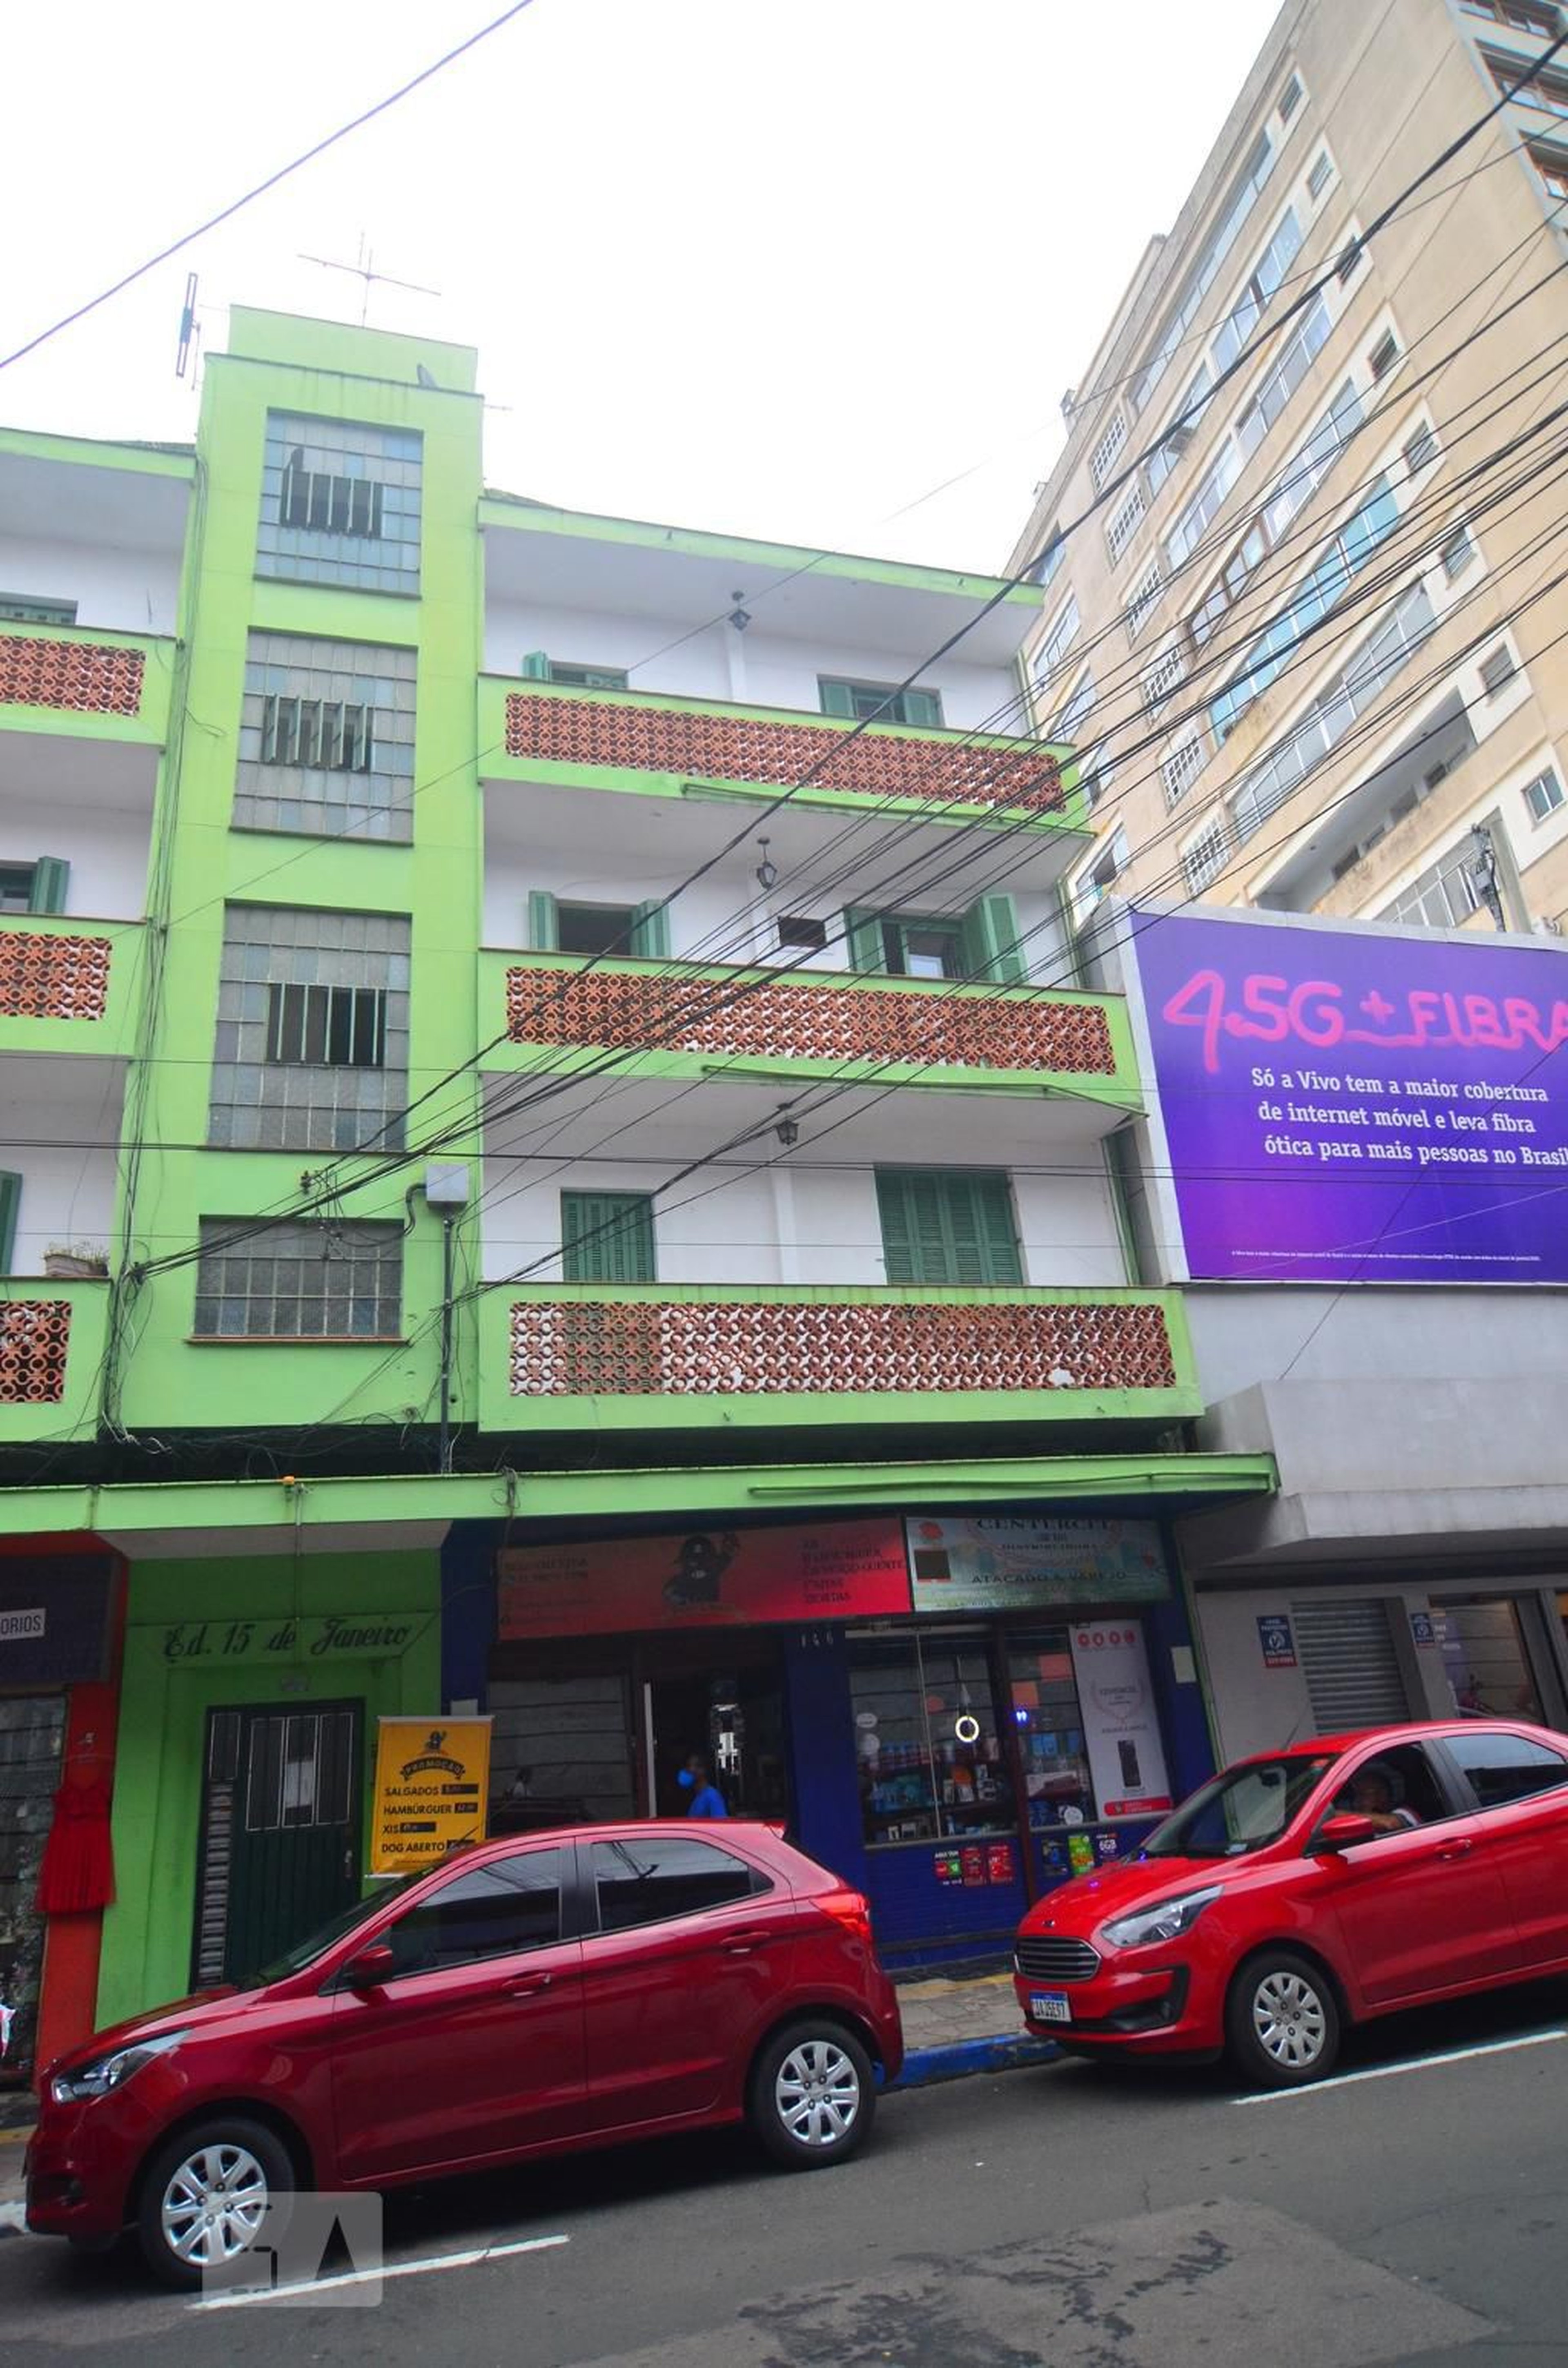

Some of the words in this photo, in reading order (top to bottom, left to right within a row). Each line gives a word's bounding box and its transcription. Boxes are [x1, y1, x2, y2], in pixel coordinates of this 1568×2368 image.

[1252, 1067, 1274, 1087] Só
[1281, 1074, 1294, 1088] a
[1297, 1071, 1341, 1091] Vivo
[1345, 1074, 1384, 1093] tem
[1389, 1080, 1401, 1095] a
[1405, 1078, 1458, 1097] maior
[1464, 1081, 1548, 1102] cobertura
[1258, 1101, 1283, 1120] de
[1287, 1103, 1369, 1125] internet
[1373, 1107, 1430, 1128] móvel
[1435, 1115, 1446, 1129] e
[1448, 1110, 1488, 1130] leva
[1491, 1113, 1536, 1133] fibra
[1265, 1135, 1313, 1155] ótica
[1318, 1141, 1363, 1161] para
[1367, 1141, 1412, 1160] mais
[1417, 1145, 1488, 1165] pessoas
[1492, 1149, 1516, 1164] no
[1519, 1147, 1568, 1166] Brasil
[972, 1574, 1048, 1583] ATACADO
[268, 1623, 296, 1651] de
[312, 1618, 410, 1655] Janeiro
[385, 1786, 439, 1797] SALGADOS
[382, 1825, 399, 1835] XIS
[382, 1843, 404, 1853] DOG
[405, 1842, 445, 1852] ABERTO
